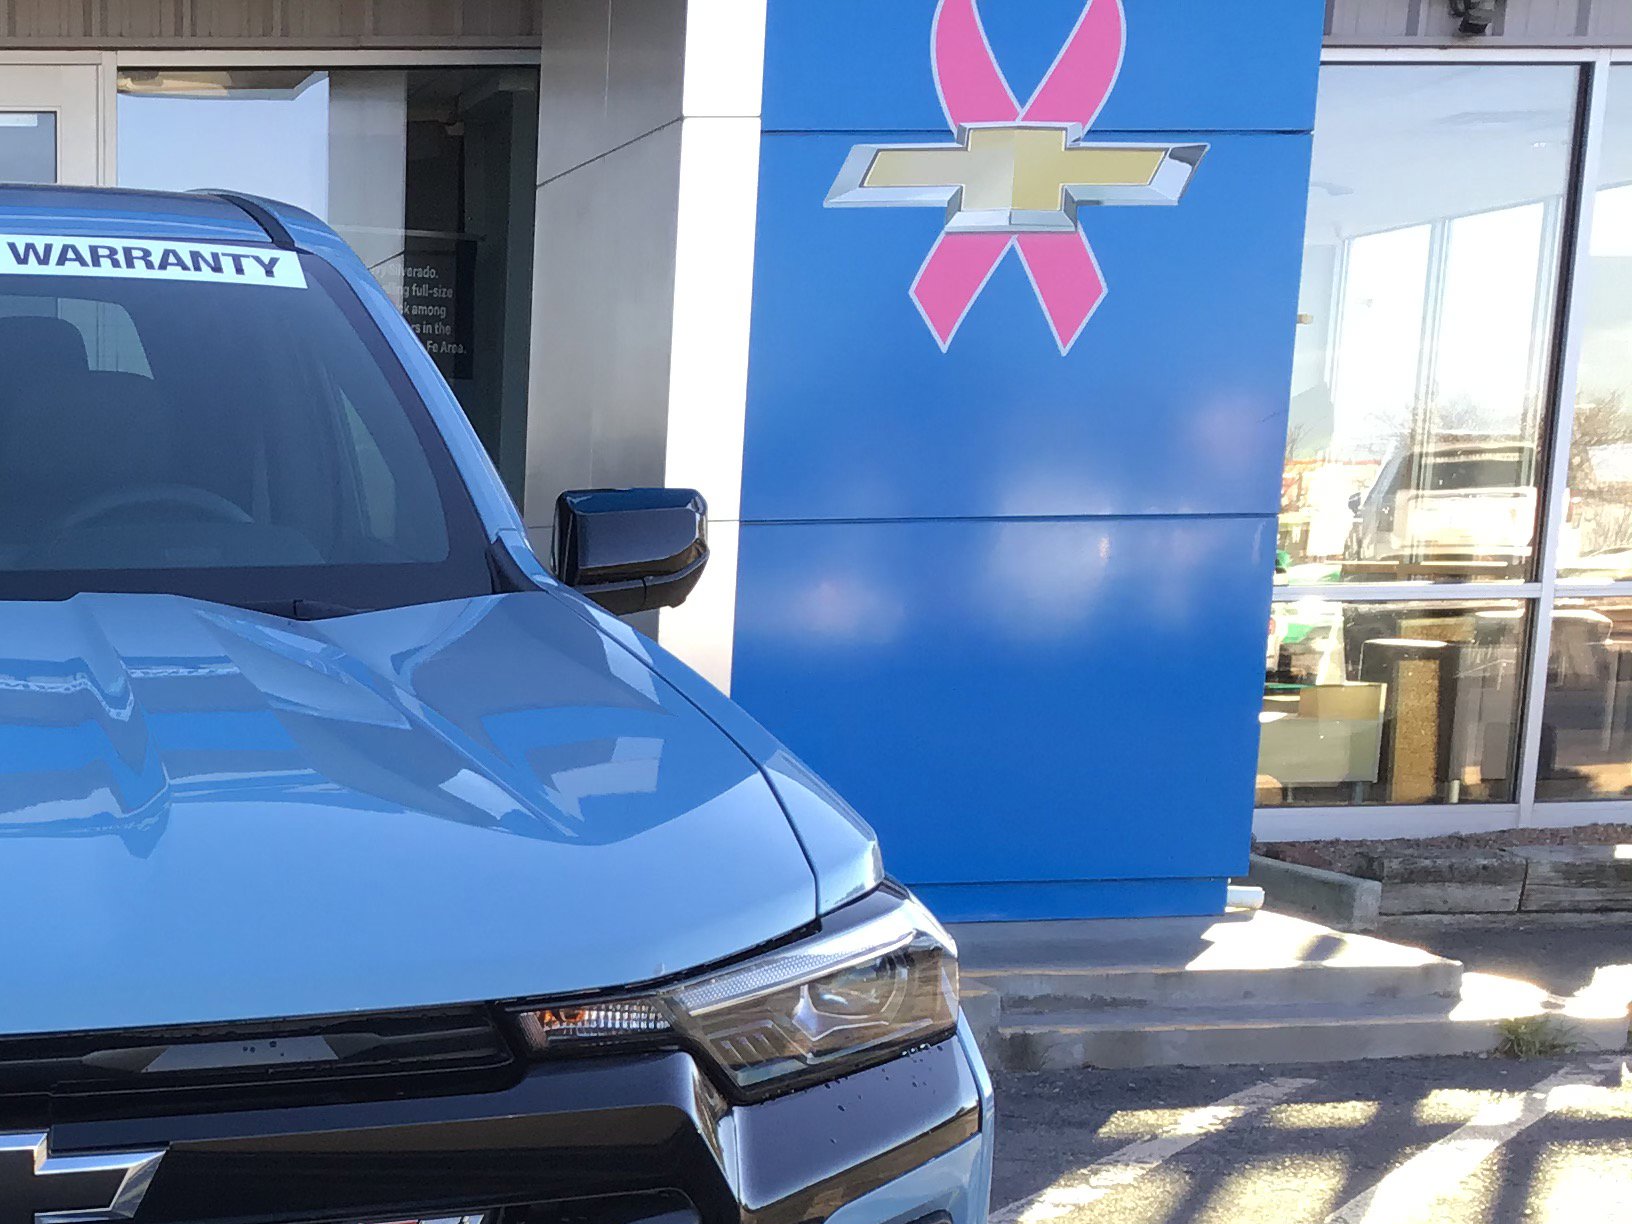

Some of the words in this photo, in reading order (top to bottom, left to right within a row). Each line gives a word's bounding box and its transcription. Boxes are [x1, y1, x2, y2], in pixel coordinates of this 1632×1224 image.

[7, 241, 280, 278] WARRANTY
[411, 283, 453, 298] full-size
[411, 304, 446, 318] among
[423, 322, 432, 334] in
[435, 321, 451, 335] the
